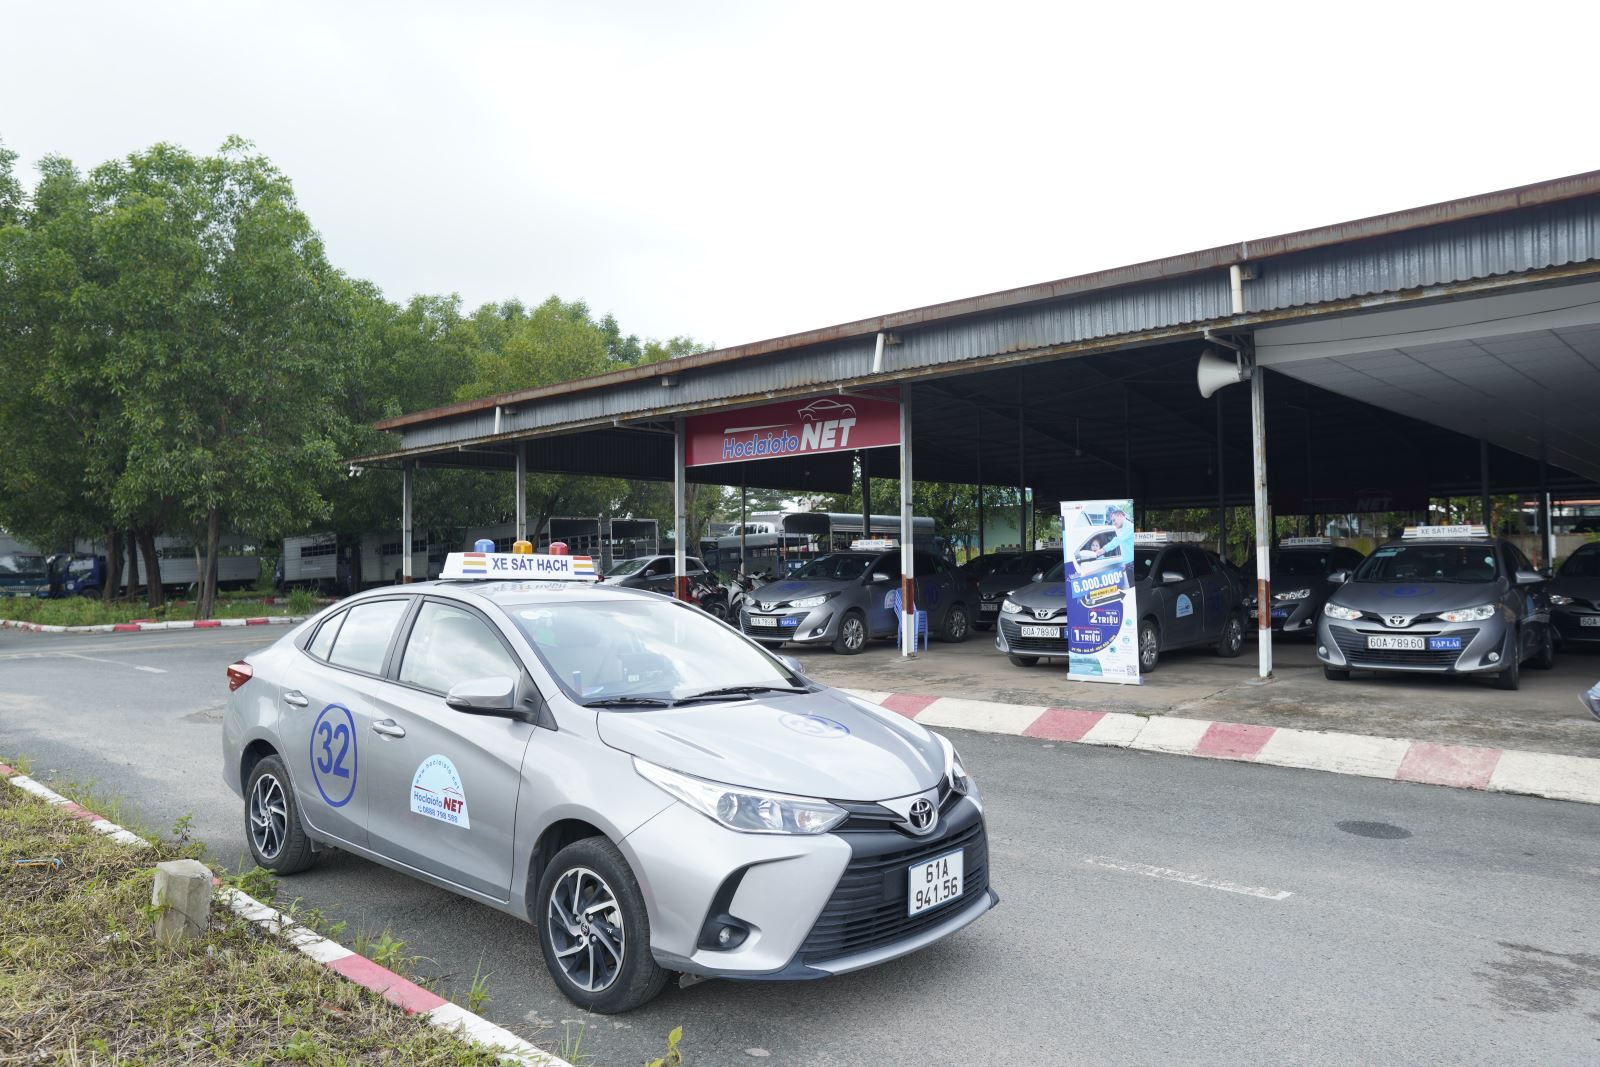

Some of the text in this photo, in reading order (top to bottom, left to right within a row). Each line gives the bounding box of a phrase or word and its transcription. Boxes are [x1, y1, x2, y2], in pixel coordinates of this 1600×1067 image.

[722, 418, 856, 459] Hoclaioto NET
[492, 555, 568, 574] XE SÁT HẠCH
[1089, 611, 1098, 624] 2
[1074, 629, 1080, 642] 1
[317, 721, 350, 778] 32
[413, 791, 464, 814] Hoclaioto NET
[926, 858, 949, 883] 61A
[916, 876, 958, 910] 941.56
